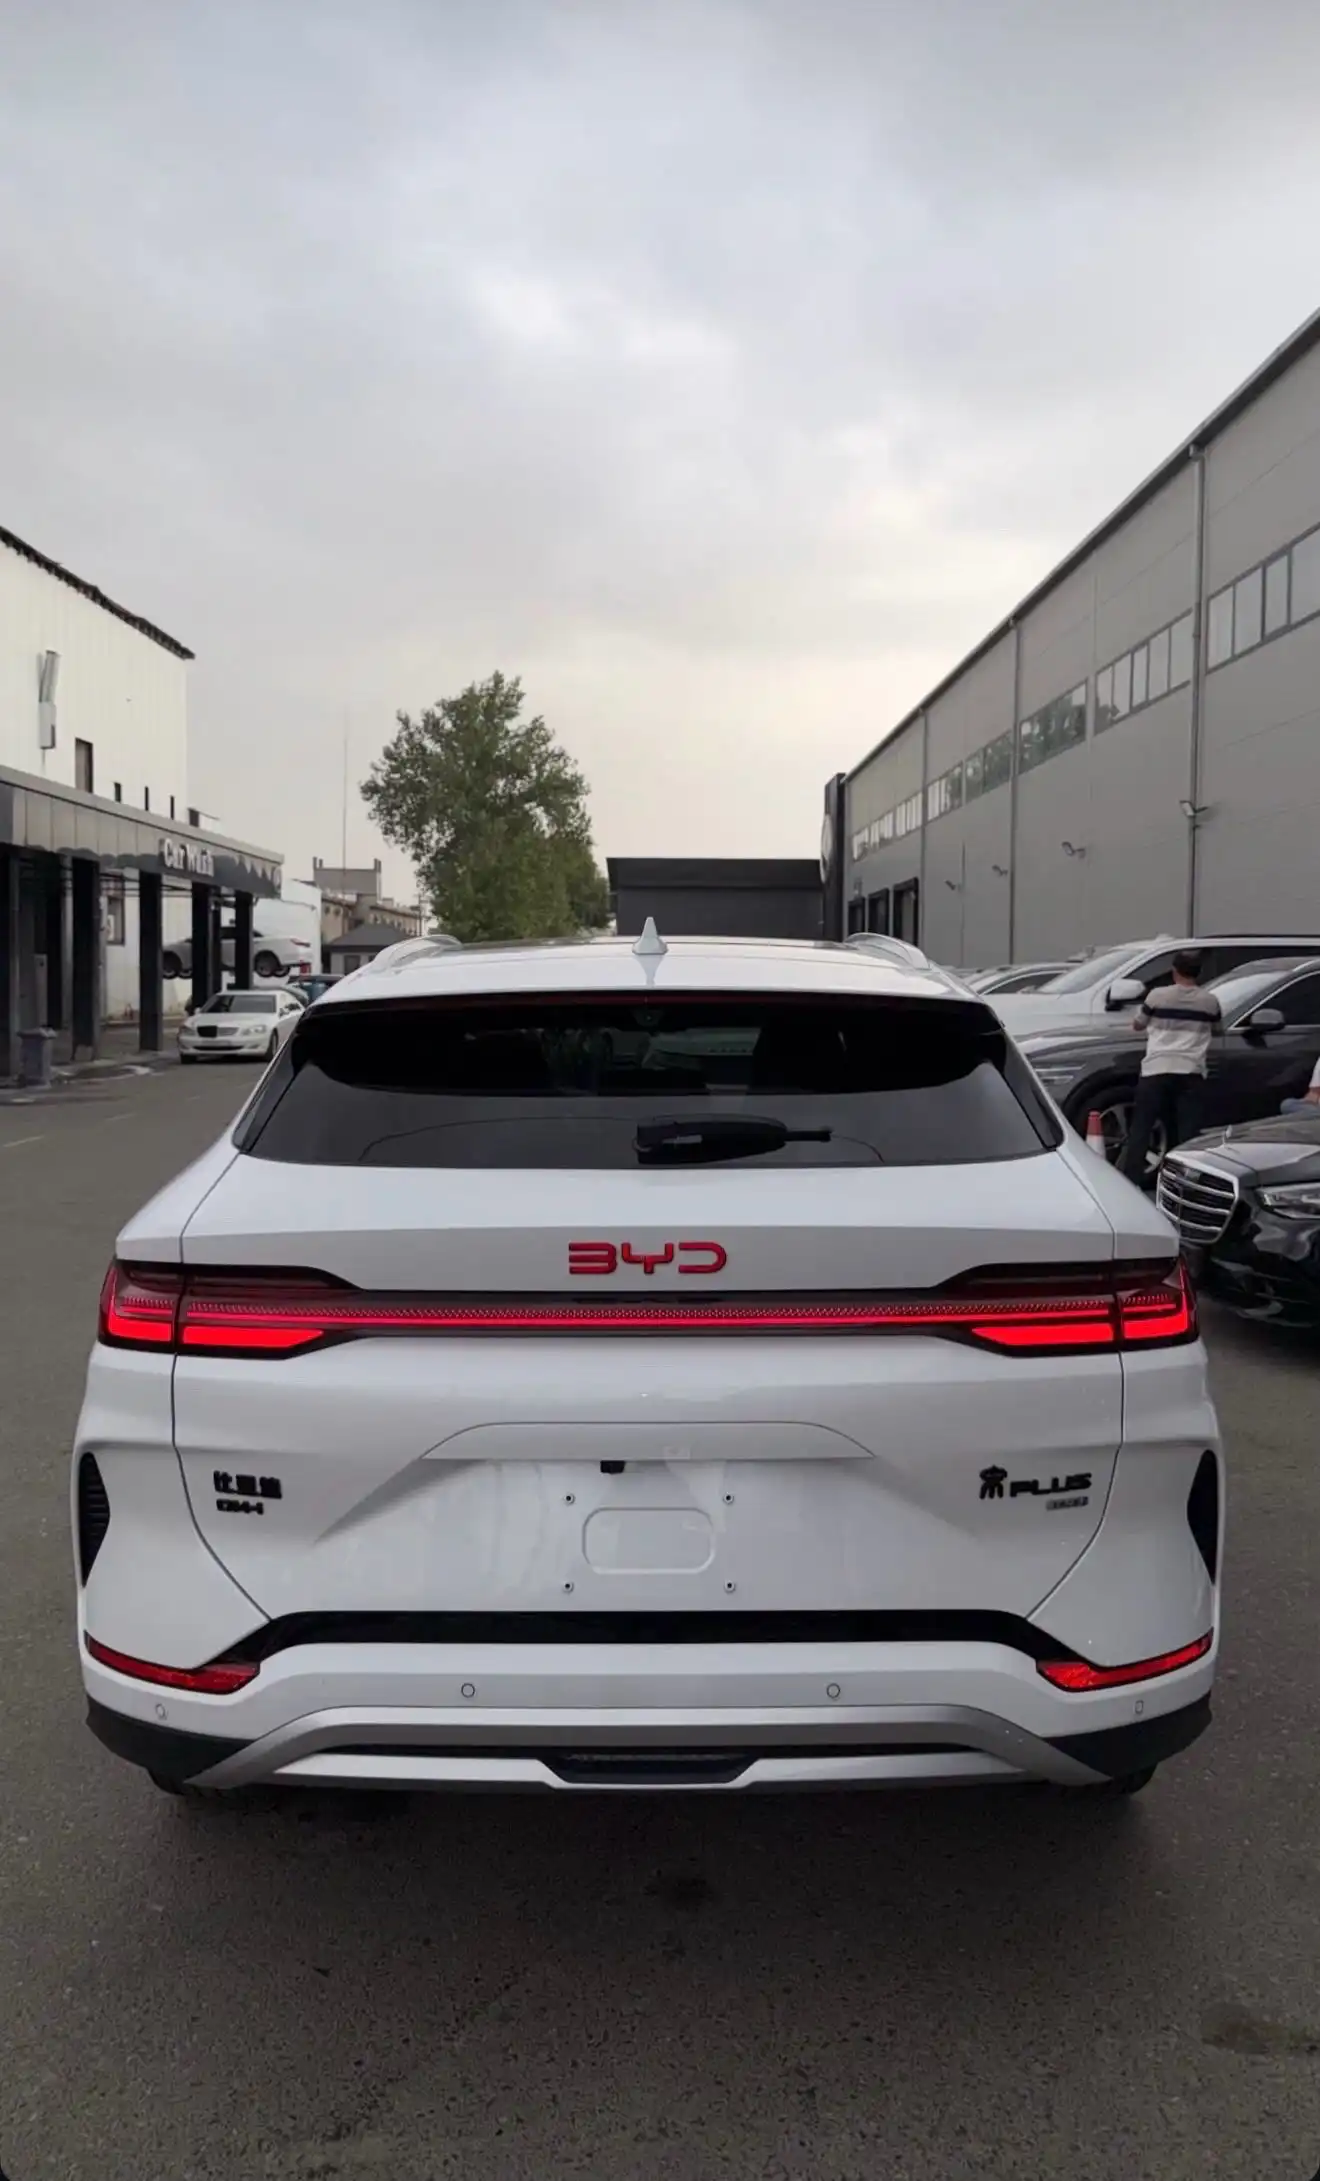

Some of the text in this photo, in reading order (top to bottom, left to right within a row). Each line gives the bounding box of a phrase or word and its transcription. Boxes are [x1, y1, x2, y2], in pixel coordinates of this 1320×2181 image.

[164, 838, 185, 870] Car
[568, 1242, 727, 1275] BYD
[1010, 1472, 1092, 1498] PLUS
